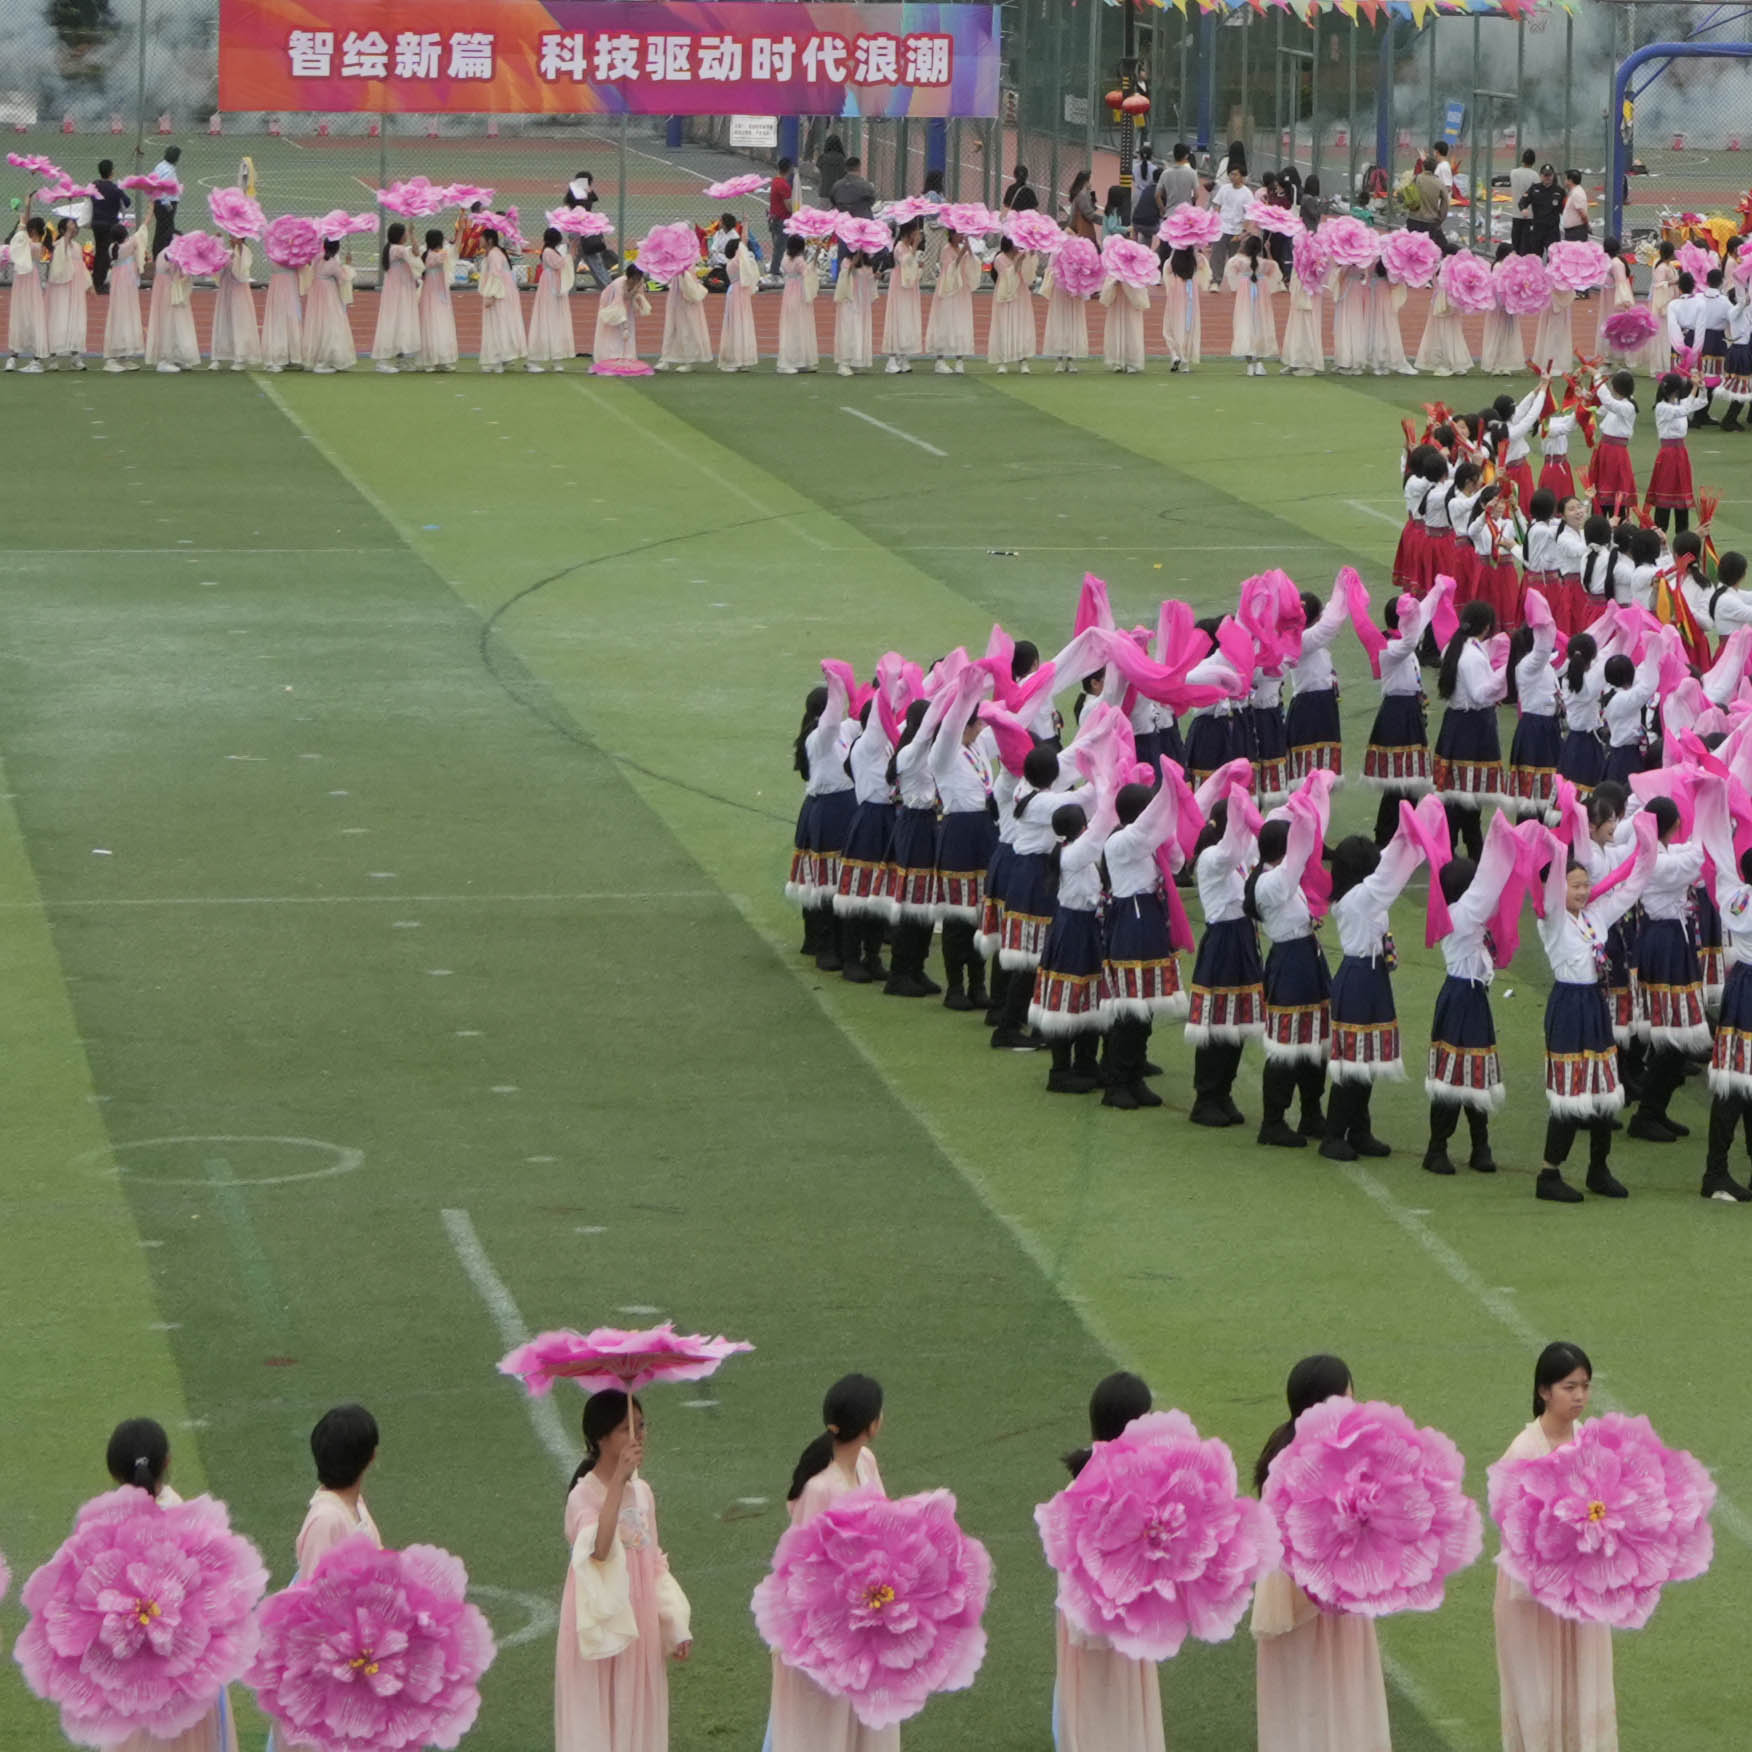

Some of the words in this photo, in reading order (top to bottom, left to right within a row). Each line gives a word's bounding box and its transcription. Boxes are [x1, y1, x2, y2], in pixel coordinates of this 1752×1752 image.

[288, 30, 494, 79] 智绘新篇
[539, 34, 949, 84] 科技驱动时代浪潮
